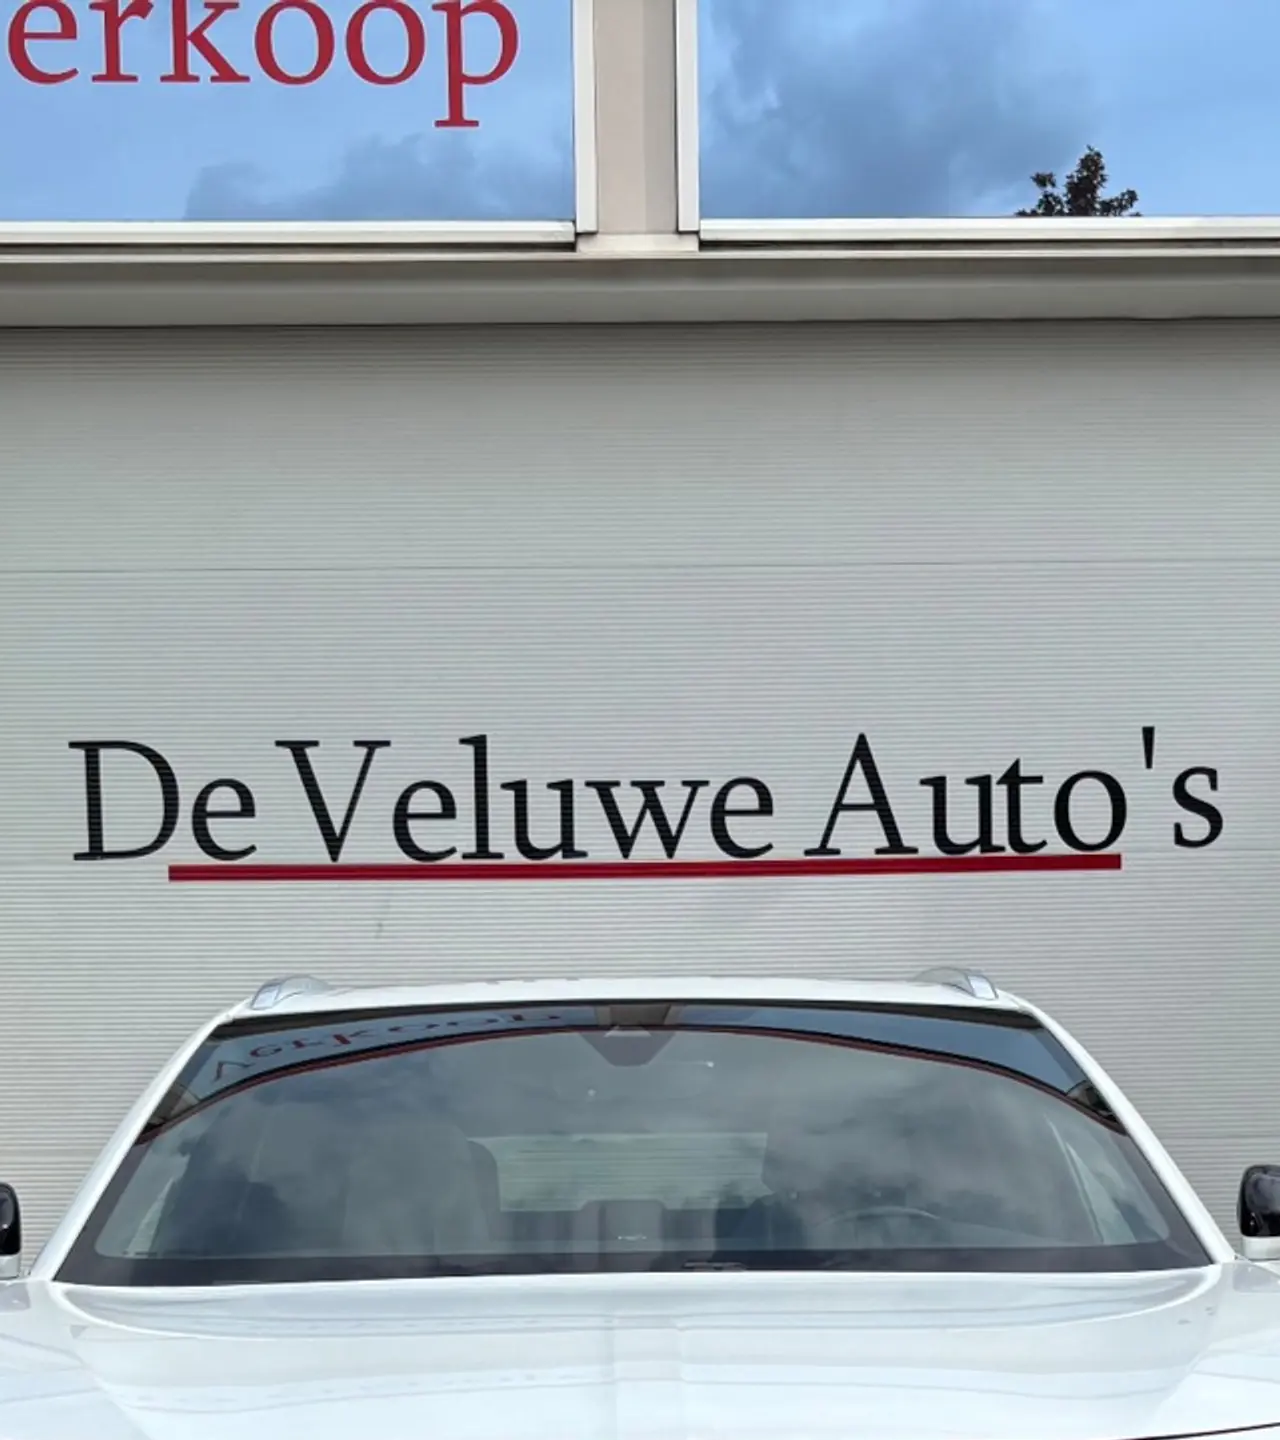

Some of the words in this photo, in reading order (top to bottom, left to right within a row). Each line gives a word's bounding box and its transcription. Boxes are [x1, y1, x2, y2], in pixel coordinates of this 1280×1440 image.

[67, 739, 258, 862] De
[273, 733, 775, 864] Veluwe
[802, 725, 1224, 858] Auto's
